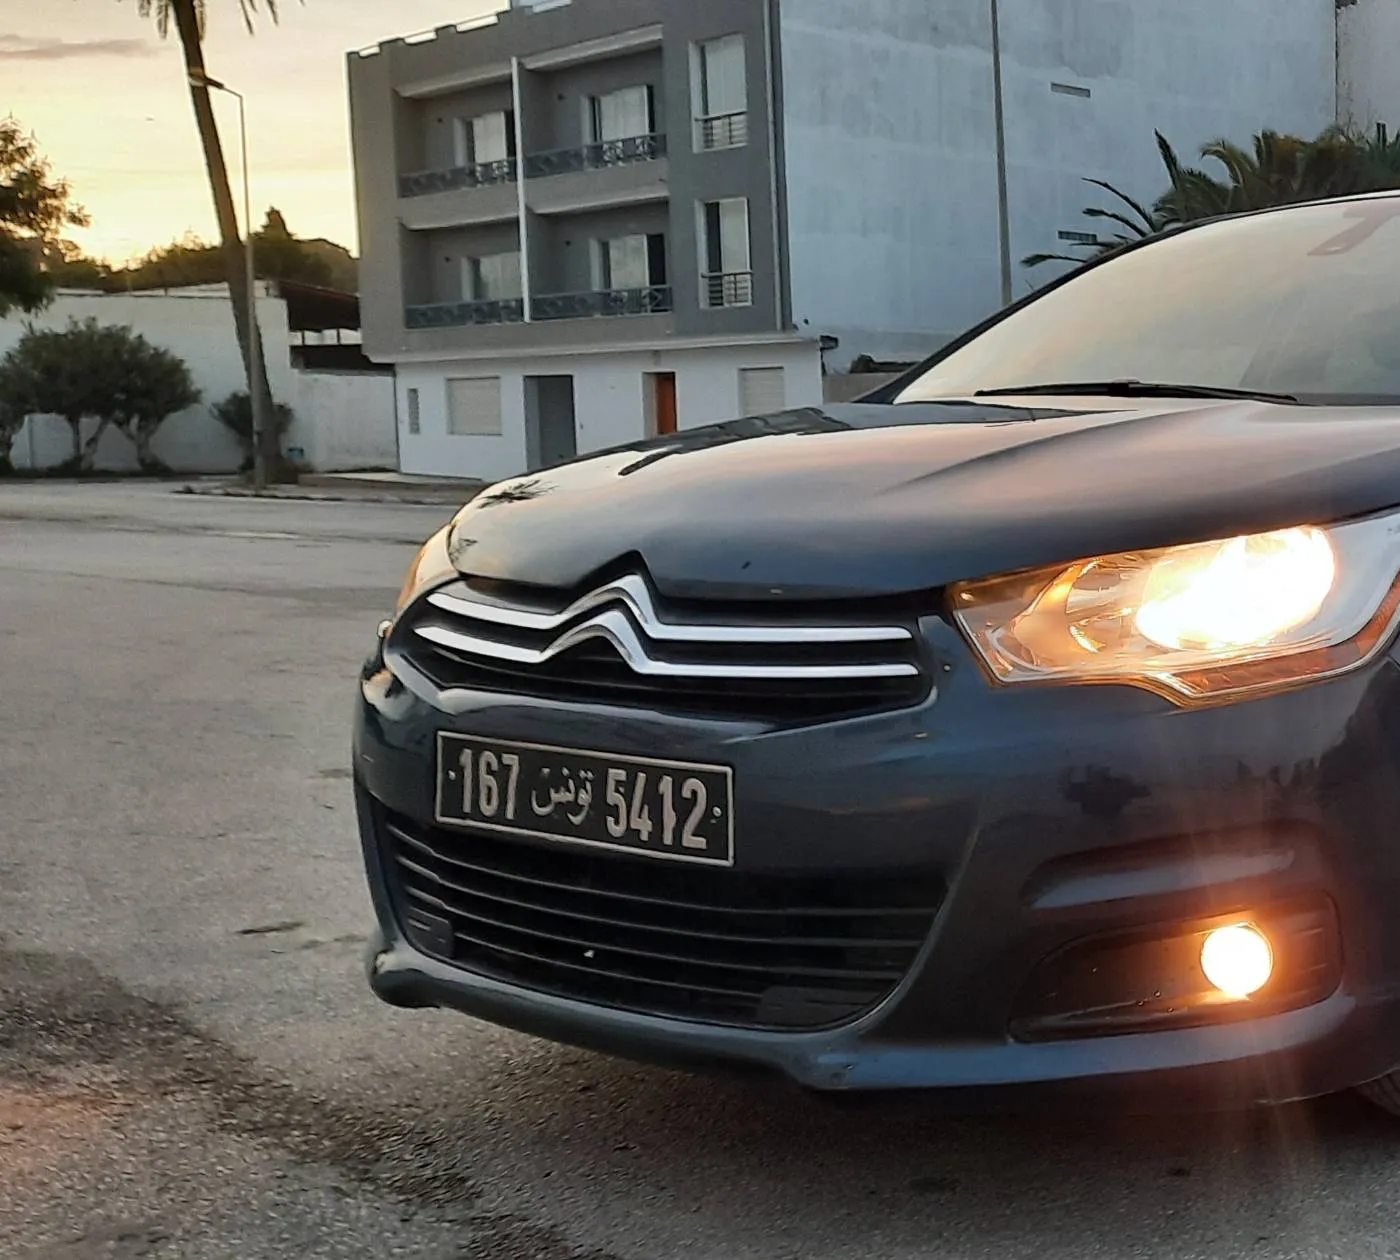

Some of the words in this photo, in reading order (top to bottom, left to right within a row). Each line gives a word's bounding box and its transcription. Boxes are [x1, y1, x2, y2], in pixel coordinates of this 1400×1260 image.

[459, 748, 519, 820] 167
[531, 766, 595, 825] تونس
[605, 767, 707, 849] 5412
